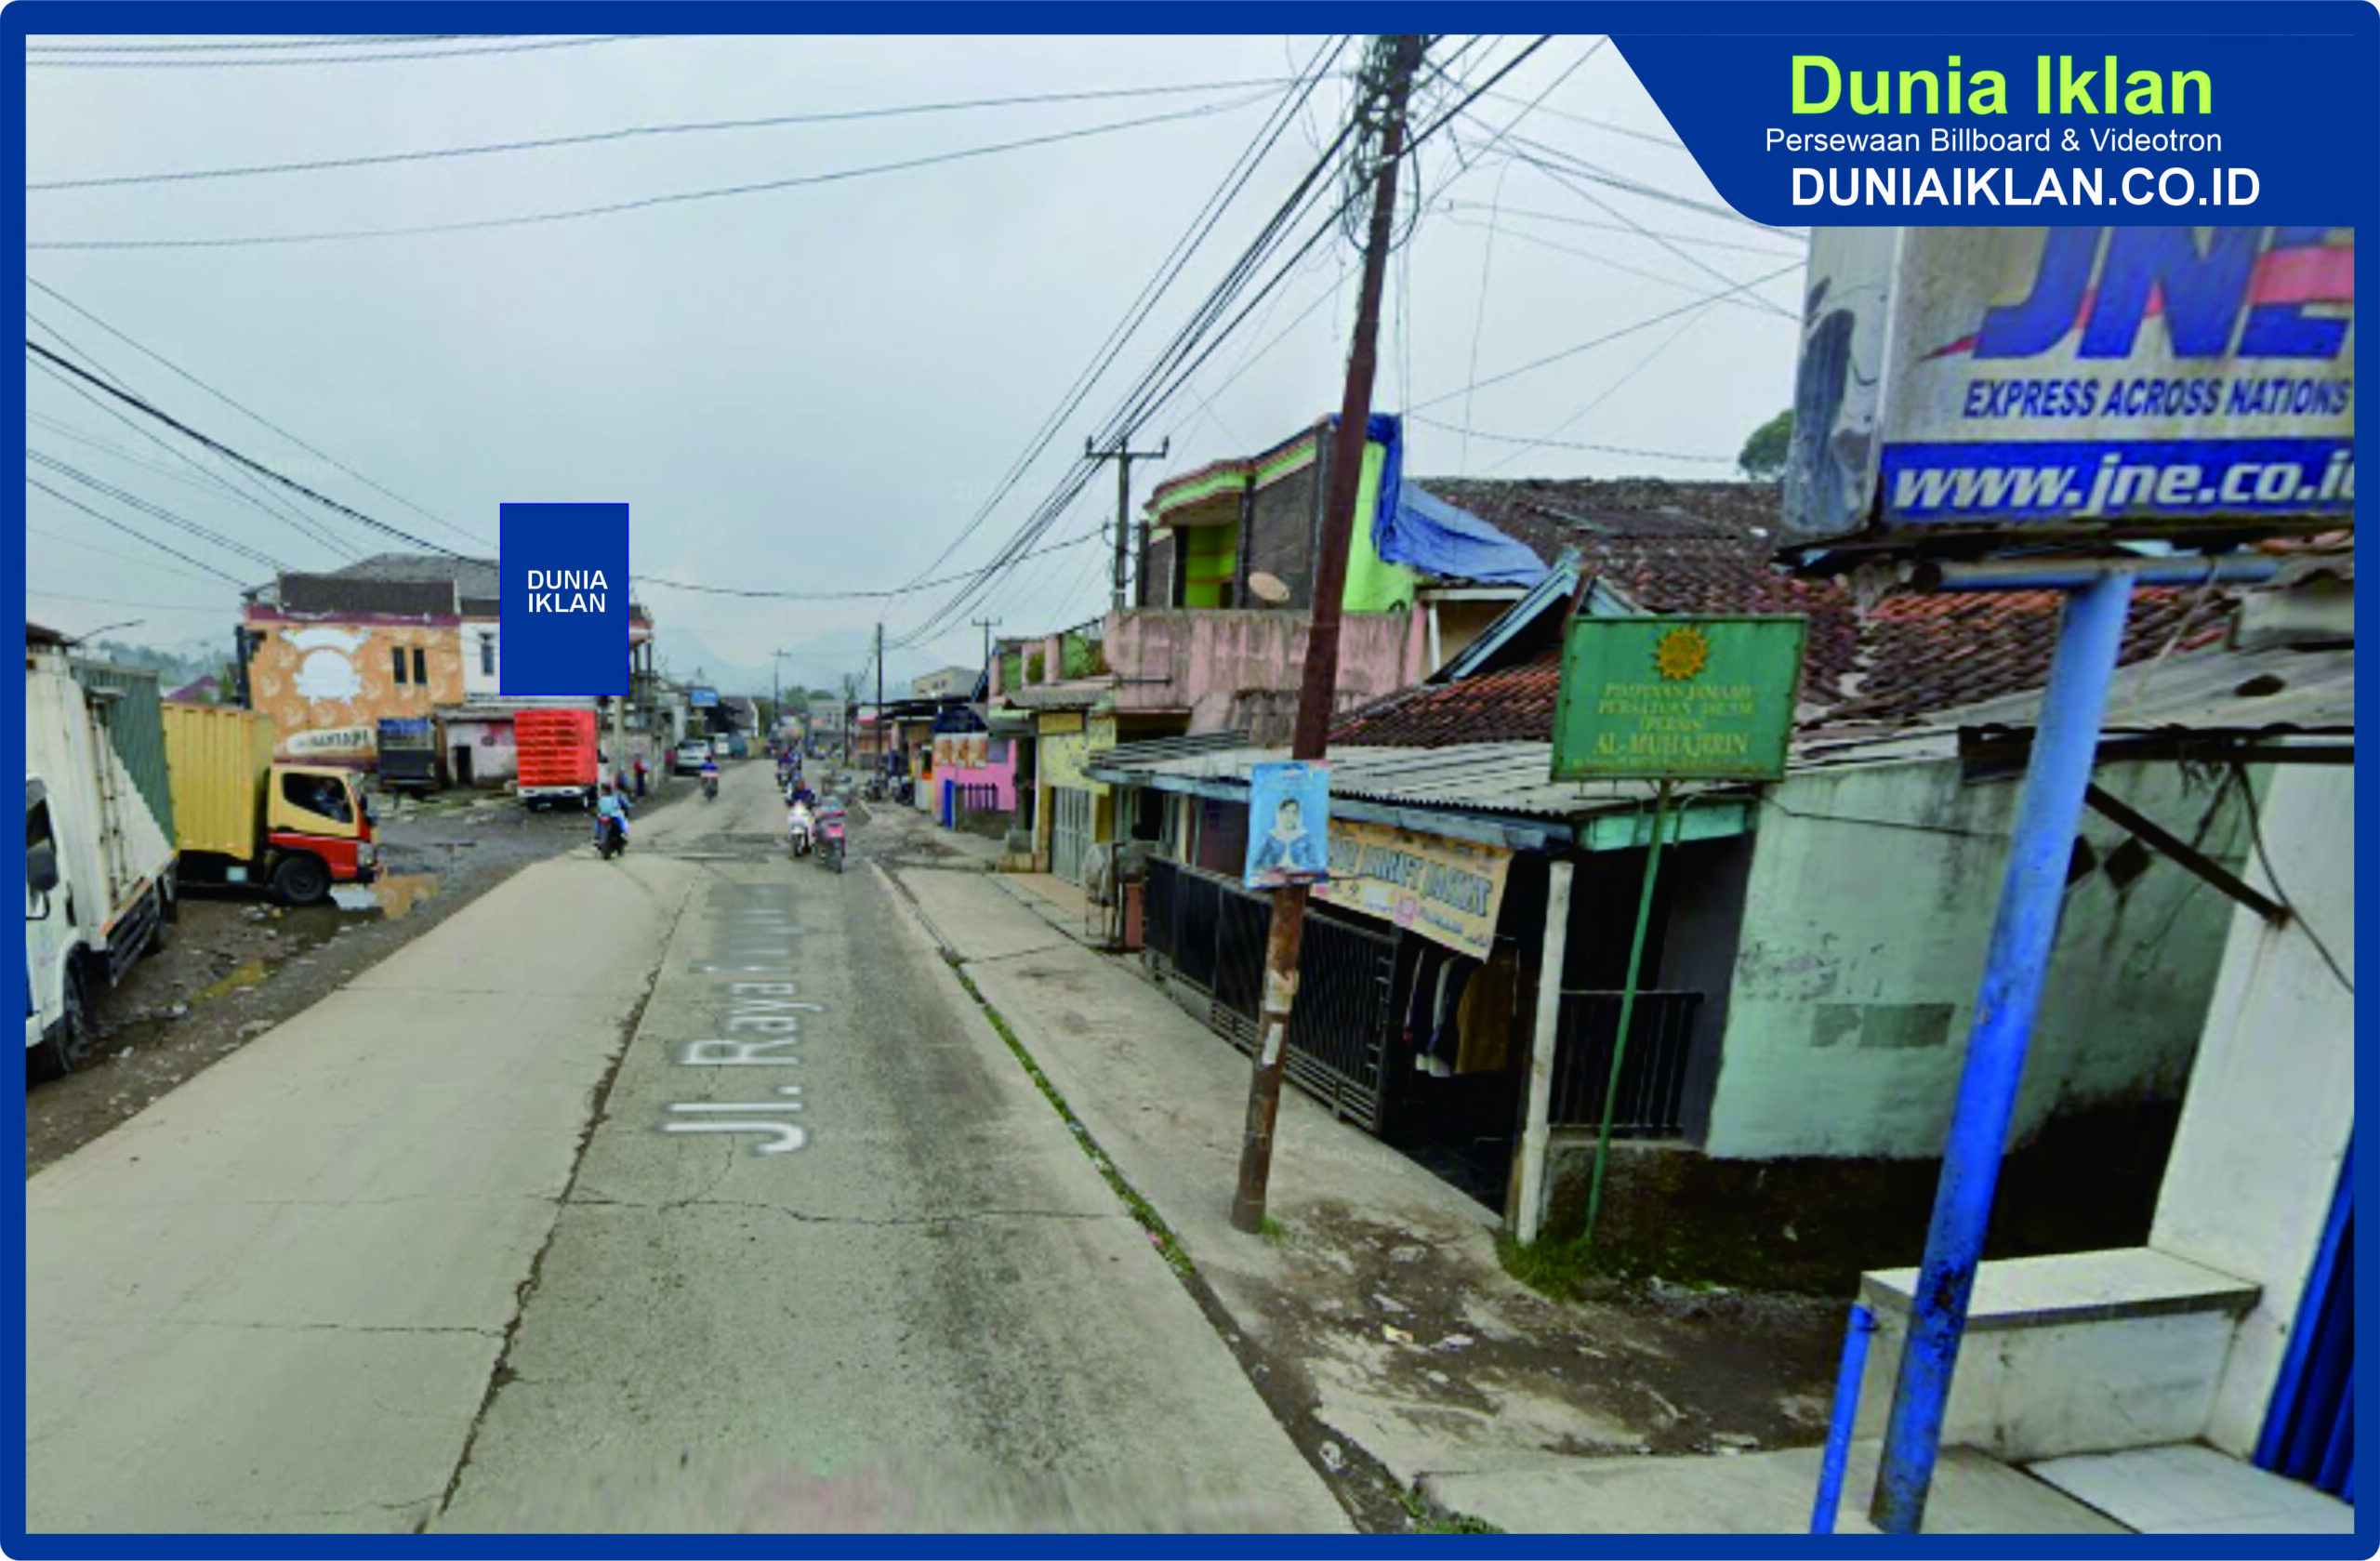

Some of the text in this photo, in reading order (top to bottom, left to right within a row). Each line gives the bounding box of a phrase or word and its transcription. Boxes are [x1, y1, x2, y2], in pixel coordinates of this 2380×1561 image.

[1973, 226, 2354, 358] JNE
[1964, 377, 2352, 417] EXPRESS ACROSS NATIONS
